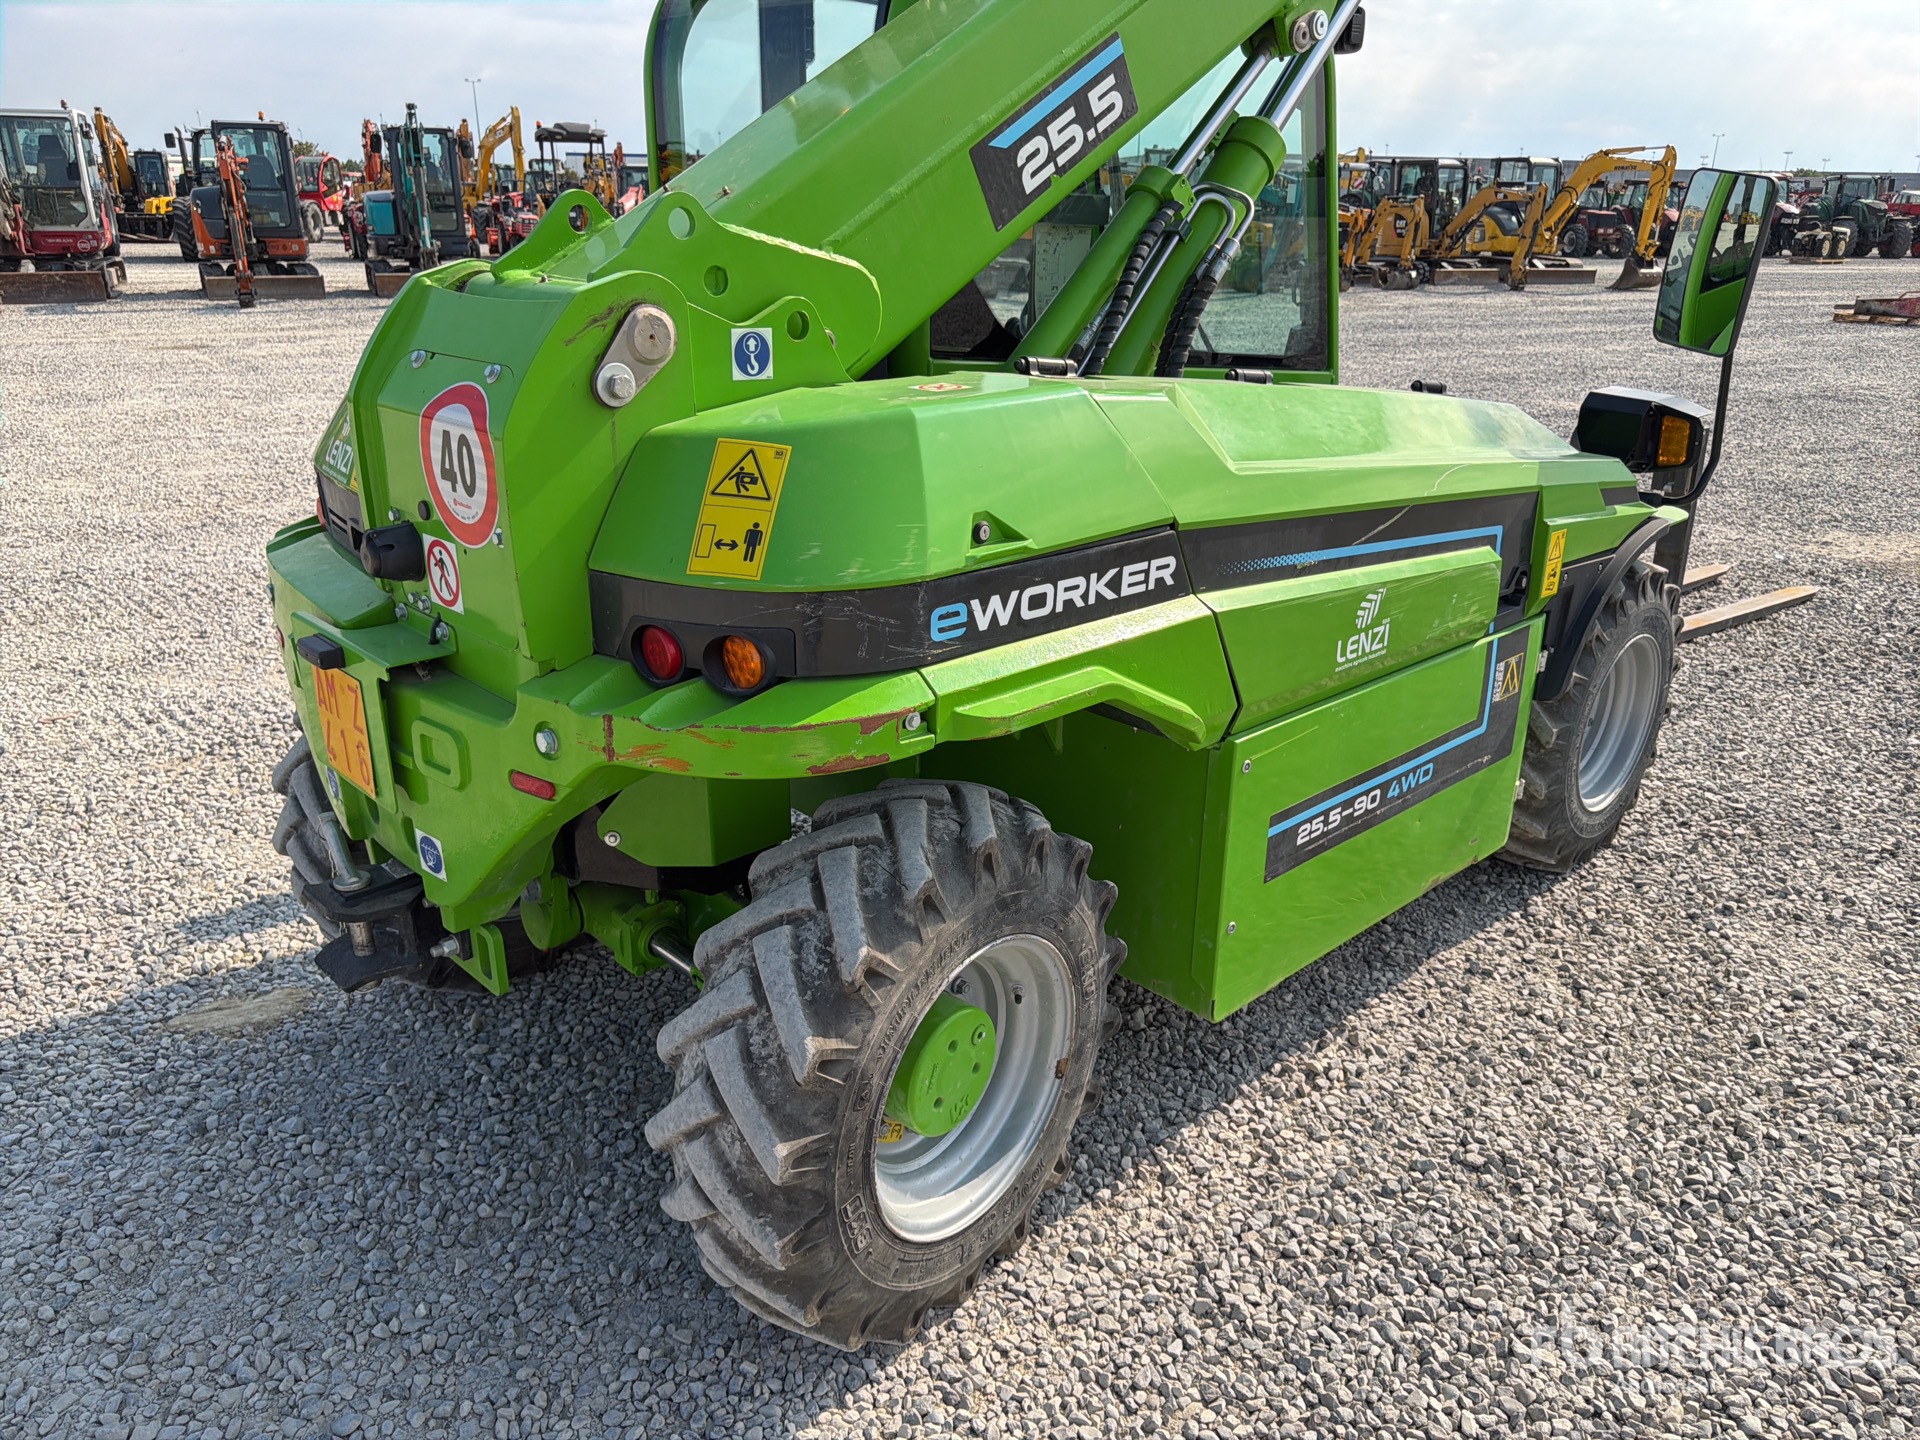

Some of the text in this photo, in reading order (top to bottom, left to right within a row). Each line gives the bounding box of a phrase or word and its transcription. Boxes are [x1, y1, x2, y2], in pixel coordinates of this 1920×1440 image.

[1016, 73, 1124, 196] 25.5
[325, 436, 354, 475] LENZI
[440, 429, 477, 498] 40
[929, 555, 1178, 642] eWORKER
[1336, 623, 1390, 663] LENZI
[315, 667, 364, 736] AM Z
[1296, 762, 1435, 846] 25.5-90 4WD
[840, 1194, 873, 1255] BKT
